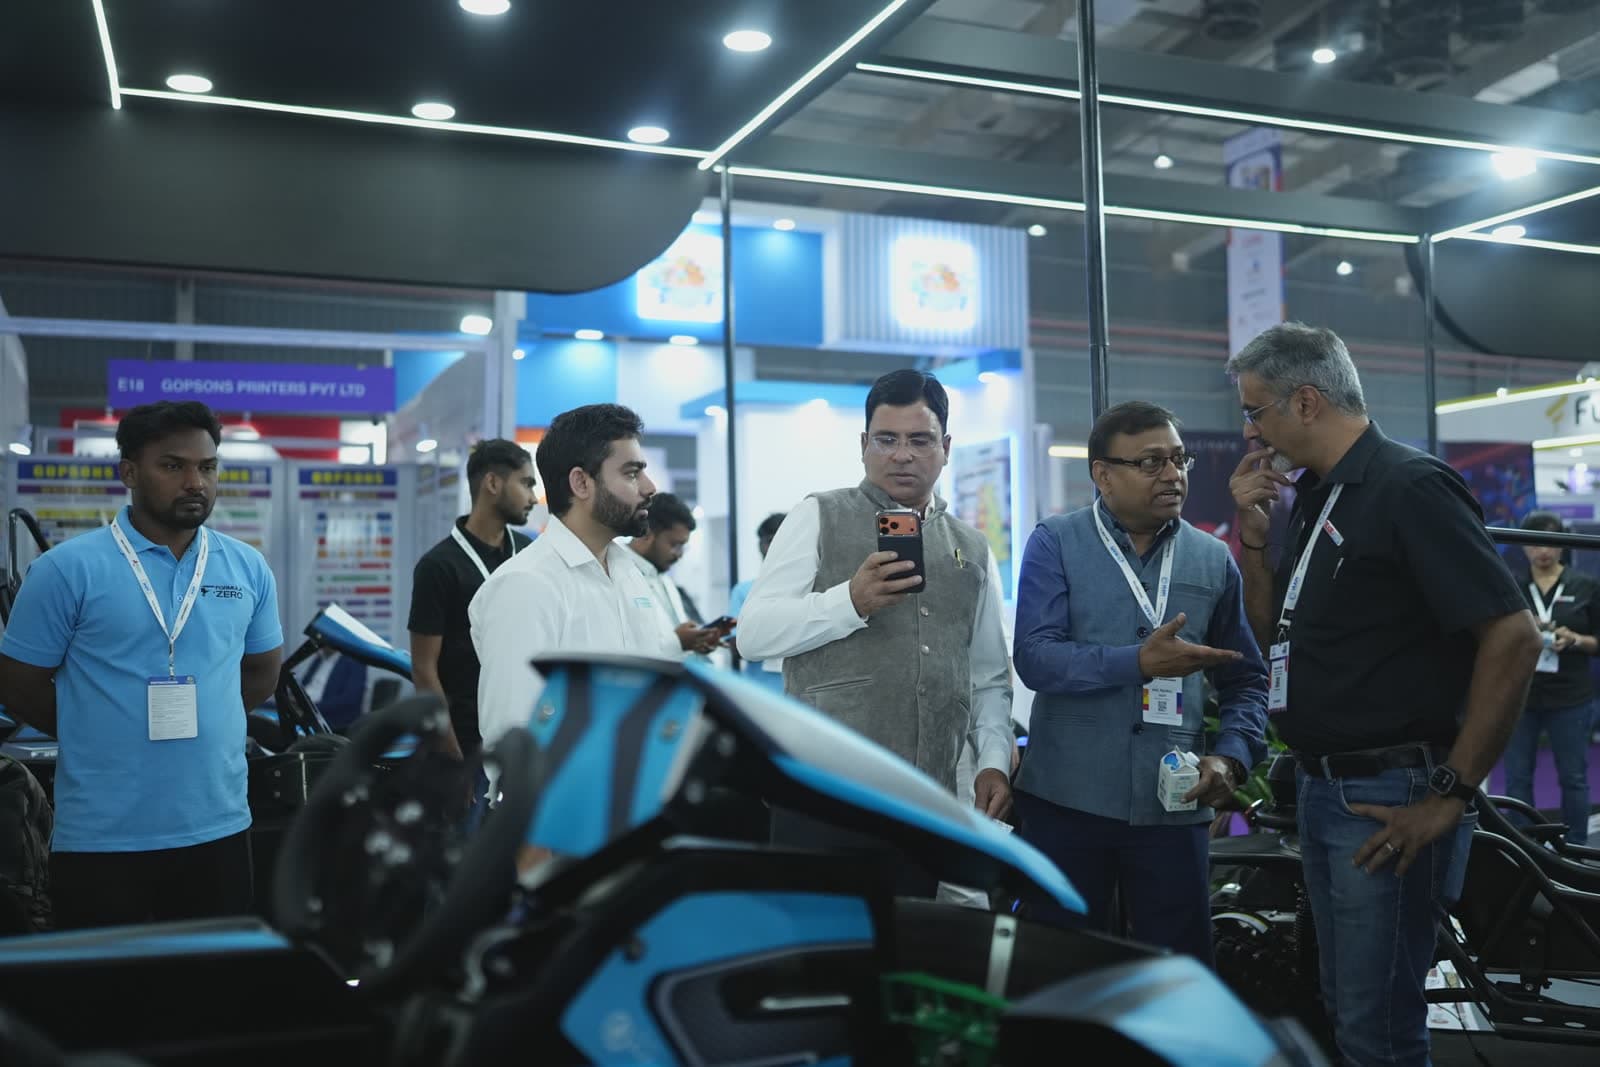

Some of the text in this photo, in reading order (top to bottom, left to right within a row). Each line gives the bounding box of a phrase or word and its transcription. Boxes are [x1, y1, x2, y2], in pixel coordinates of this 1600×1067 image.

[118, 377, 365, 398] E18 GOPSONS PRINTERS PVT LTD
[215, 590, 243, 600] ZERO
